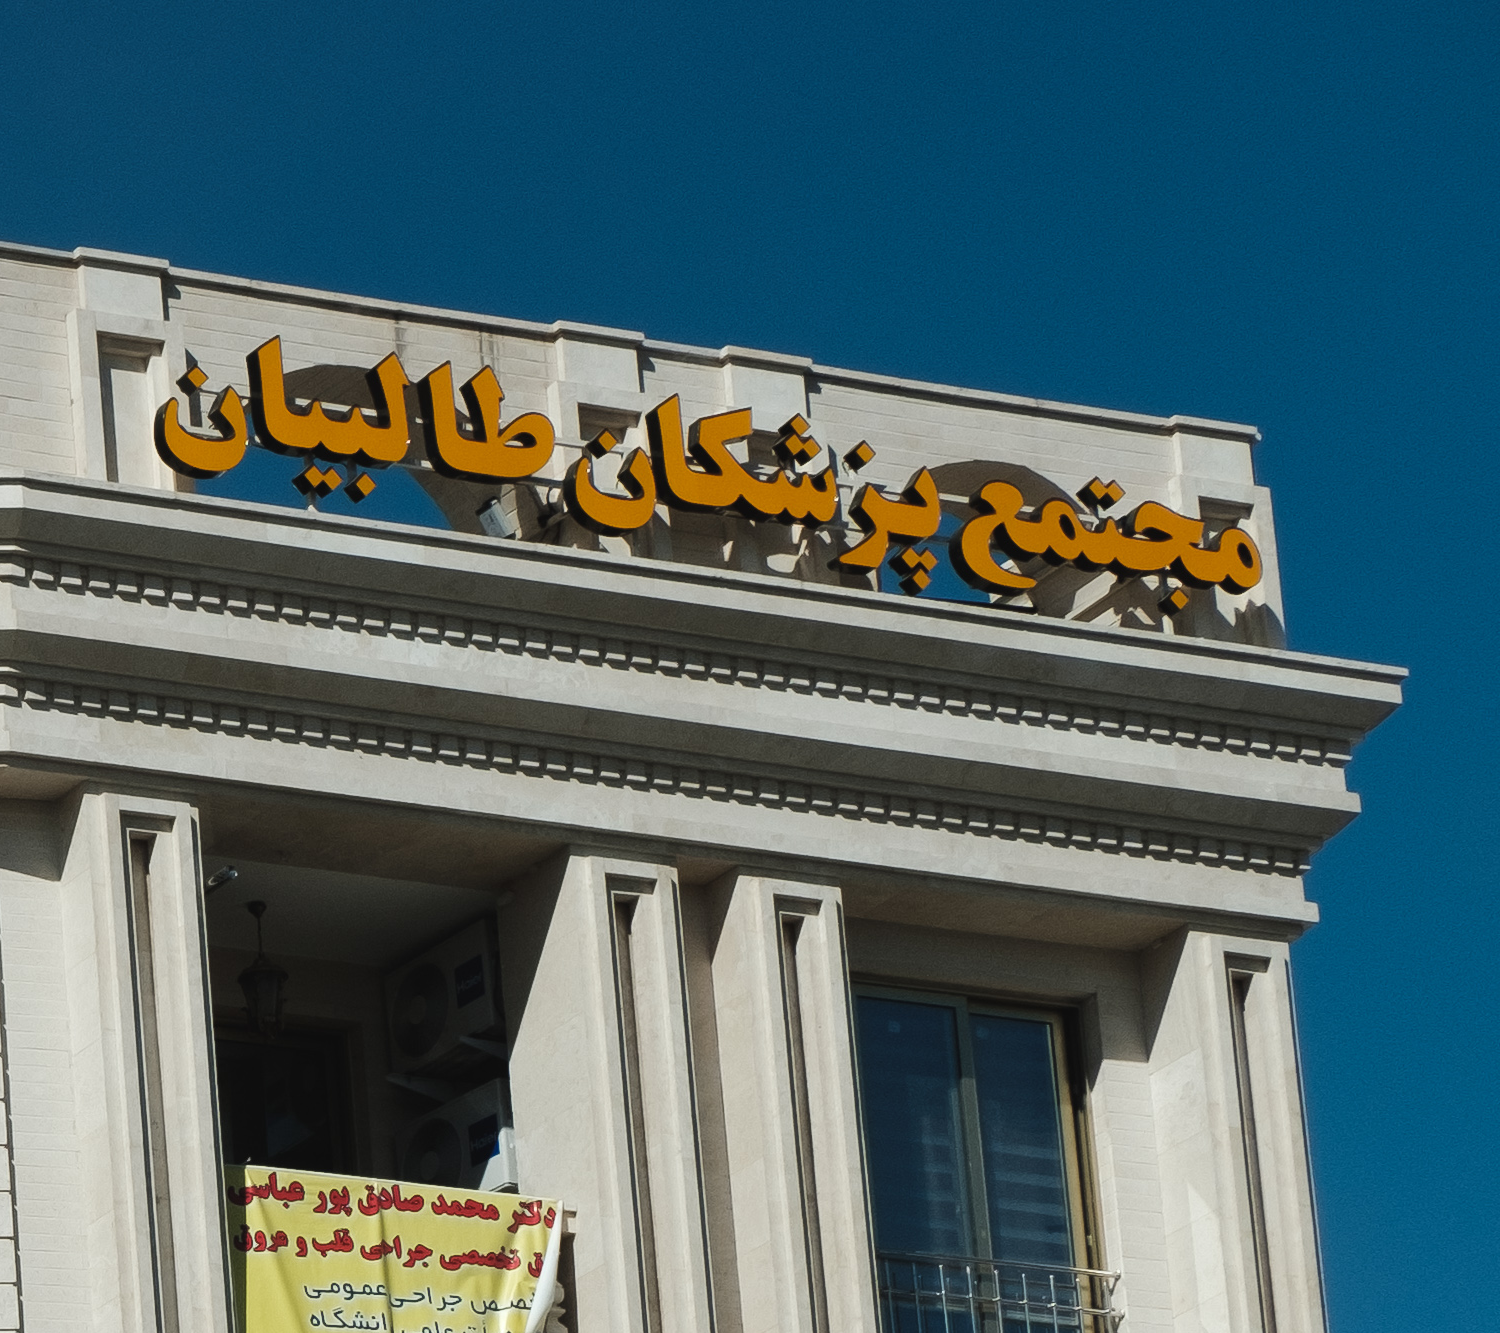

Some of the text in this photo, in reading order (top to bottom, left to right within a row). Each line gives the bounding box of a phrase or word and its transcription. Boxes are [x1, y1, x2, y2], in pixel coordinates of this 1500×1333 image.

[154, 334, 1264, 615] مجتمع پزشکان طالبیان
[227, 1171, 557, 1234] دکتر محمد صادق پور عباسی
[232, 1223, 289, 1254] عروق
[294, 1235, 309, 1258] و
[311, 1228, 354, 1258] قلب
[359, 1234, 434, 1269] جراحی
[439, 1245, 522, 1272] تخصصی
[303, 1282, 389, 1301] عمومی
[389, 1286, 463, 1312] جراحی
[309, 1306, 388, 1331] انشگاه
